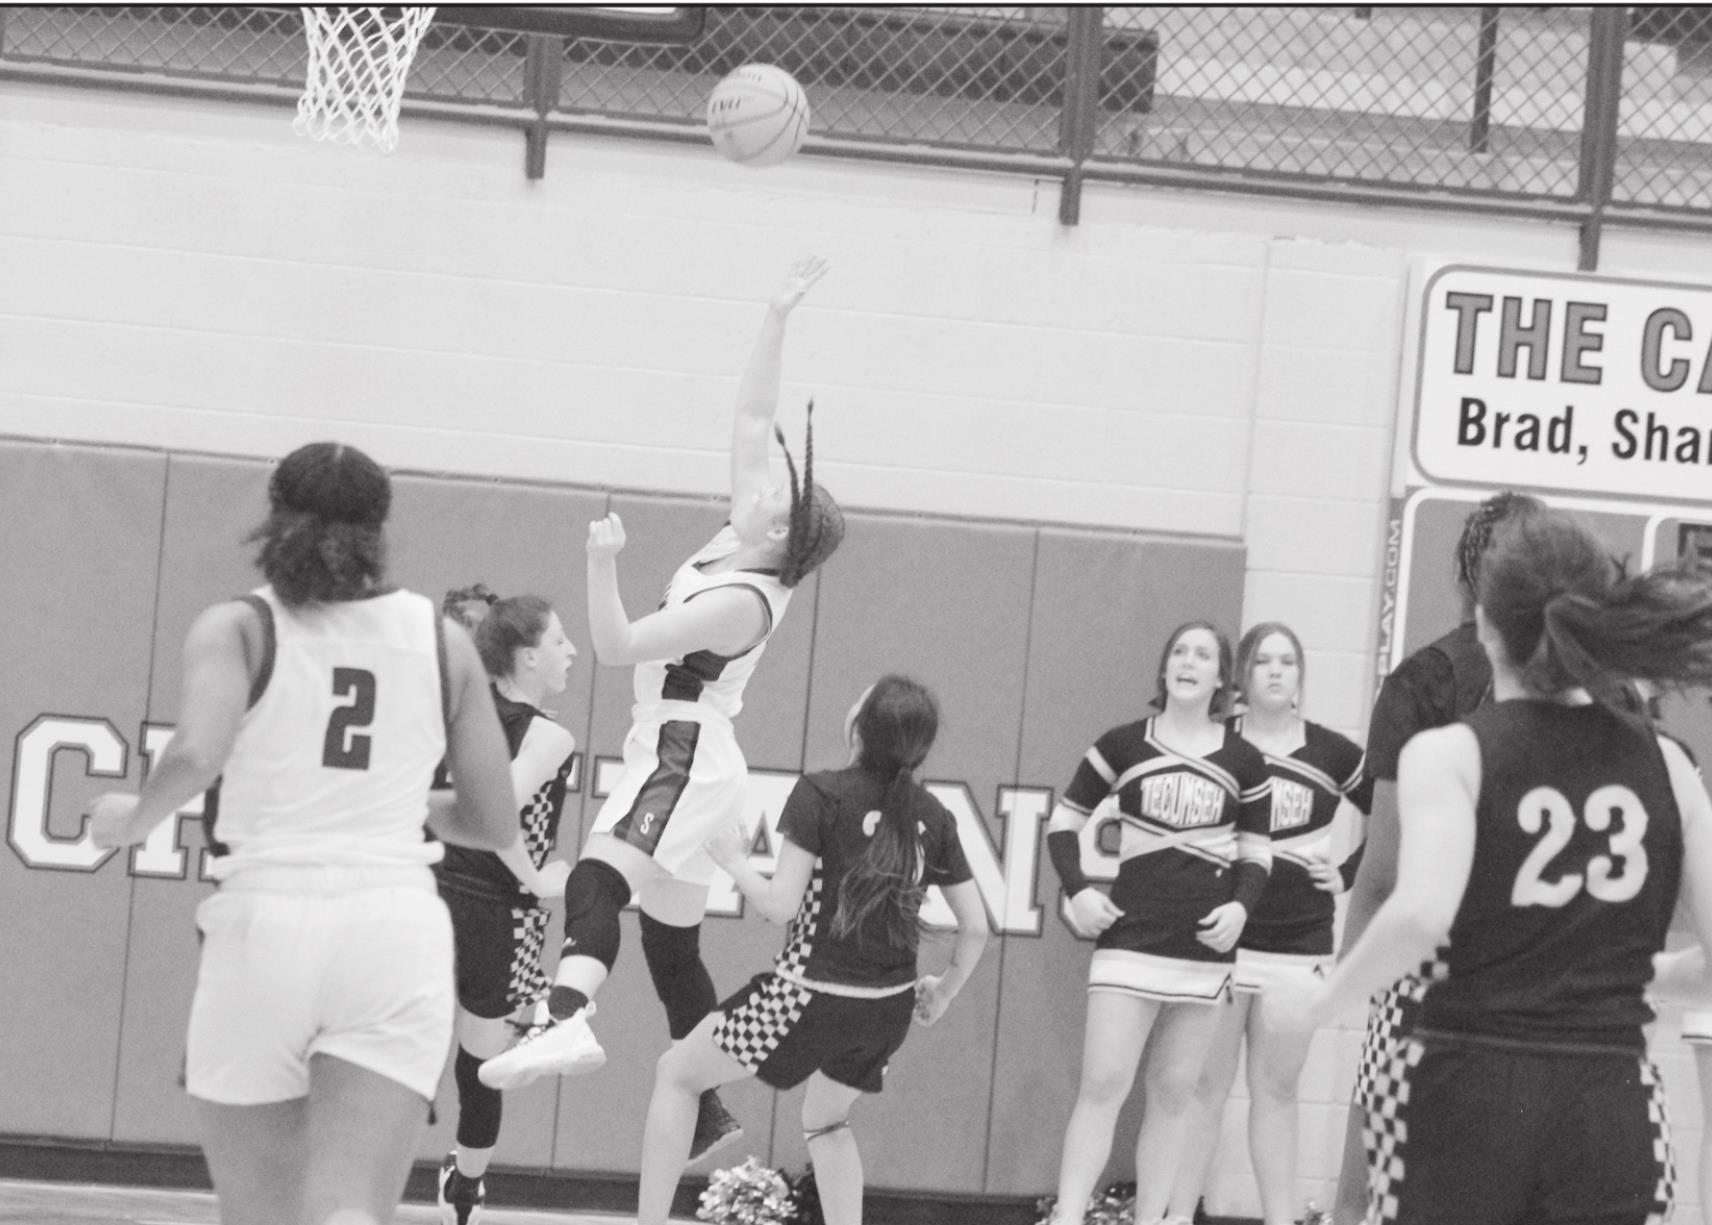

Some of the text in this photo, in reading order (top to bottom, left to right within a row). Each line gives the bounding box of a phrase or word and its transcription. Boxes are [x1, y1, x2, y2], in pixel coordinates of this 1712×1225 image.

[1445, 290, 1712, 394] THE C
[1457, 397, 1589, 466] Brad,
[1376, 518, 1401, 695] PLAY.COM
[322, 667, 377, 771] 2
[1510, 784, 1650, 908] 23
